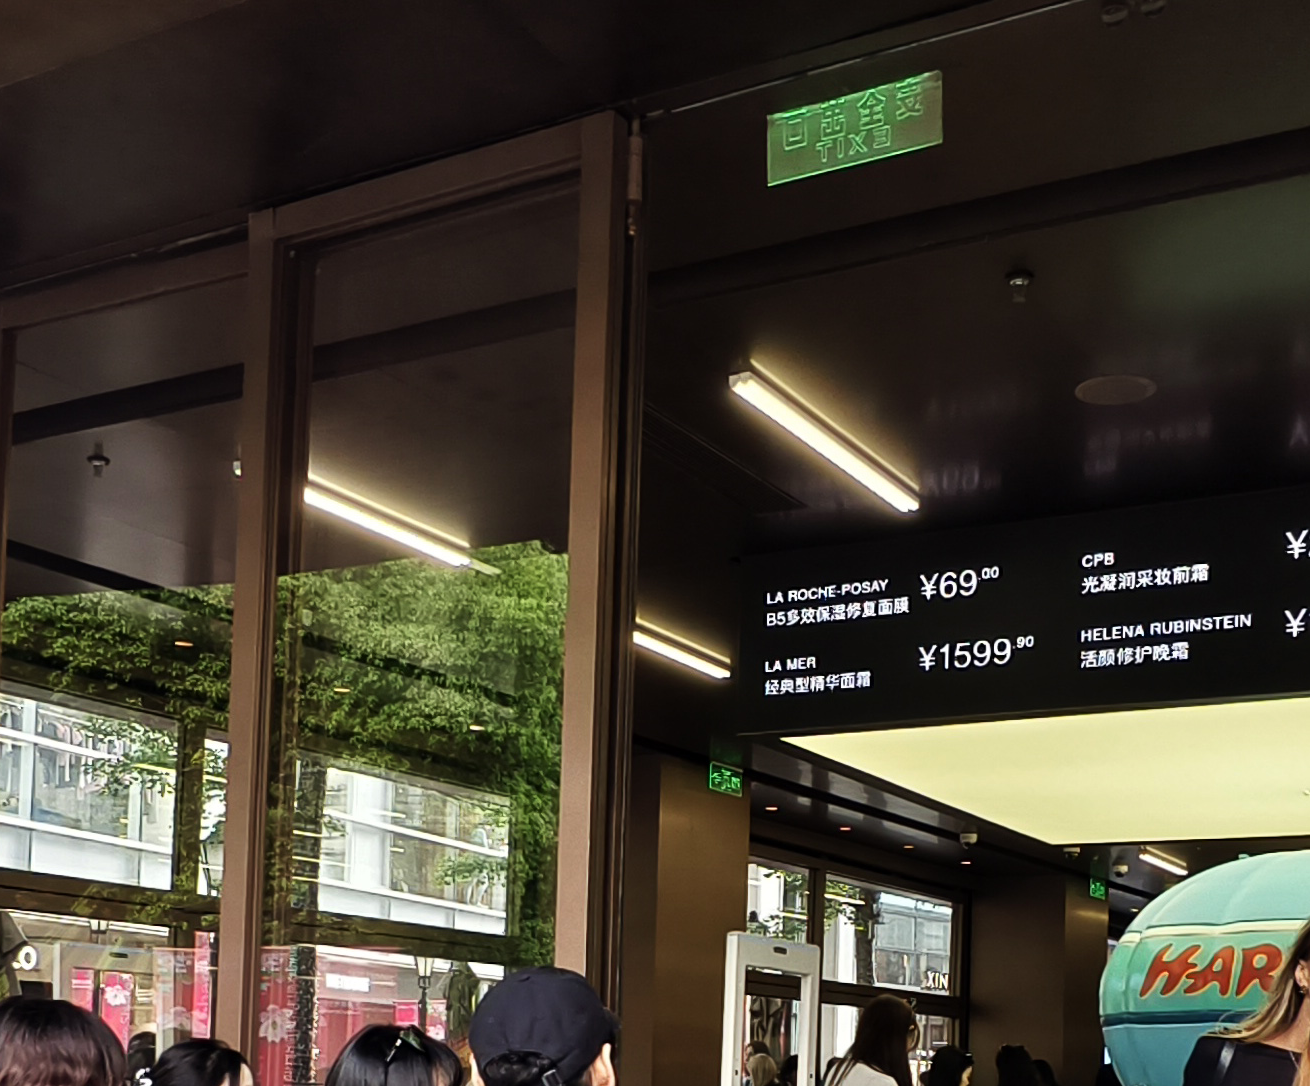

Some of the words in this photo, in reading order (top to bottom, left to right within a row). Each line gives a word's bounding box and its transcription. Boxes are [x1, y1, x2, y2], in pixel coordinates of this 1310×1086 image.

[1081, 552, 1115, 568] CPB
[766, 591, 784, 604] LA
[788, 579, 889, 602] ROCHE-POSAY
[919, 566, 1000, 600] ¥69.00
[1081, 563, 1210, 594] 光凝润采妆前霜
[766, 597, 910, 627] B5多效保湿修复面膜
[1080, 626, 1145, 643] HELENA
[1149, 613, 1252, 636] RUBINSTEIN
[765, 660, 782, 673] LA
[786, 656, 817, 670] MER
[919, 635, 1035, 671] ¥1599.90
[1080, 641, 1190, 669] 活颜修护晚霜
[764, 671, 872, 696] 经典型精华面霜
